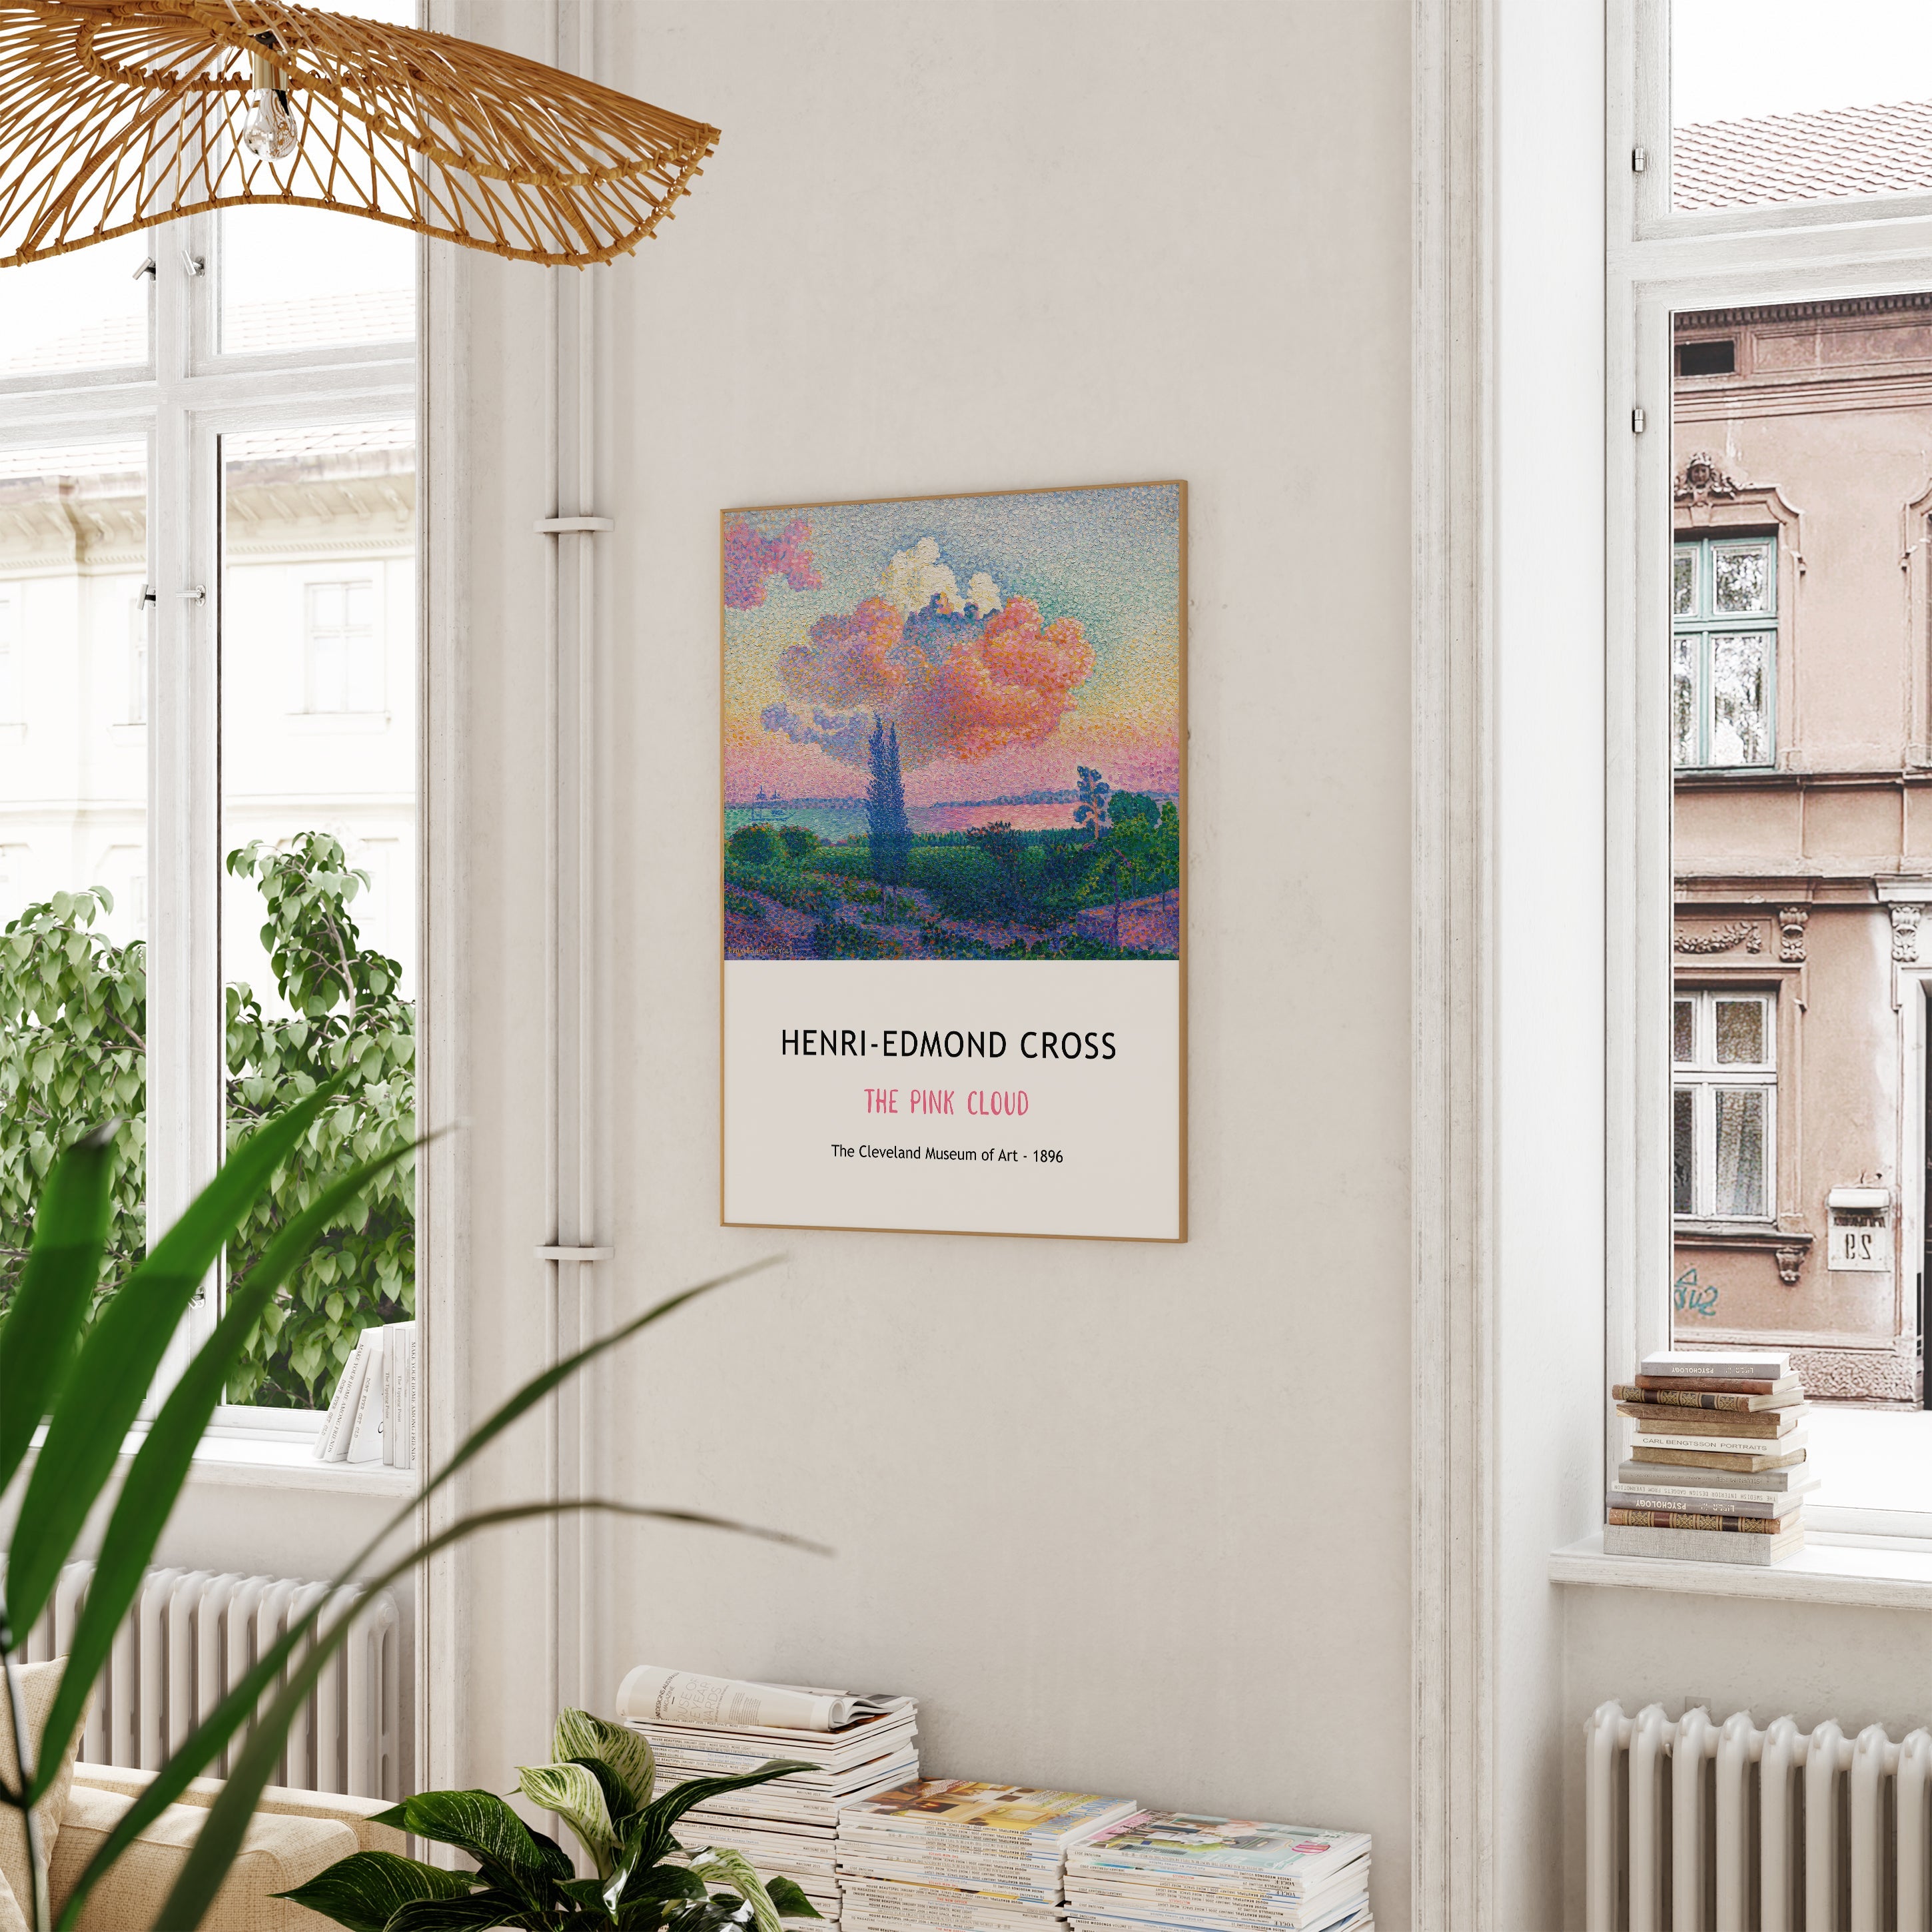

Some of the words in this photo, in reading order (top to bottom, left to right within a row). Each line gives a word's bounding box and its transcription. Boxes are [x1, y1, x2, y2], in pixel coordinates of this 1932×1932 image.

[782, 1029, 1007, 1058] HENRI-EDMOND
[1020, 1031, 1117, 1060] CROSS
[864, 1088, 899, 1114] THE
[910, 1089, 955, 1115] PINK
[967, 1090, 1029, 1116] CLOUD
[831, 1144, 855, 1158] The
[859, 1145, 921, 1160] Cleveland
[925, 1147, 977, 1161] Museum
[981, 1149, 995, 1162] of
[997, 1149, 1019, 1162] Art
[1033, 1149, 1064, 1163] 1896
[354, 1344, 364, 1362] MAKE
[349, 1363, 358, 1380] YOUR
[338, 1379, 346, 1394] DONT
[344, 1380, 354, 1400] HOME
[331, 1395, 340, 1410] EVER
[336, 1400, 346, 1426] AMONG
[328, 1426, 339, 1453] FRIENDS
[1666, 1439, 1716, 1448] BENGTSSON
[1720, 1442, 1767, 1451] PORTRAITS
[1636, 1500, 1686, 1510] PSYCHOLOGY
[655, 1690, 666, 1711] DESIGNS
[662, 1686, 675, 1712] MAGAZINE
[690, 1682, 710, 1709] YEAR
